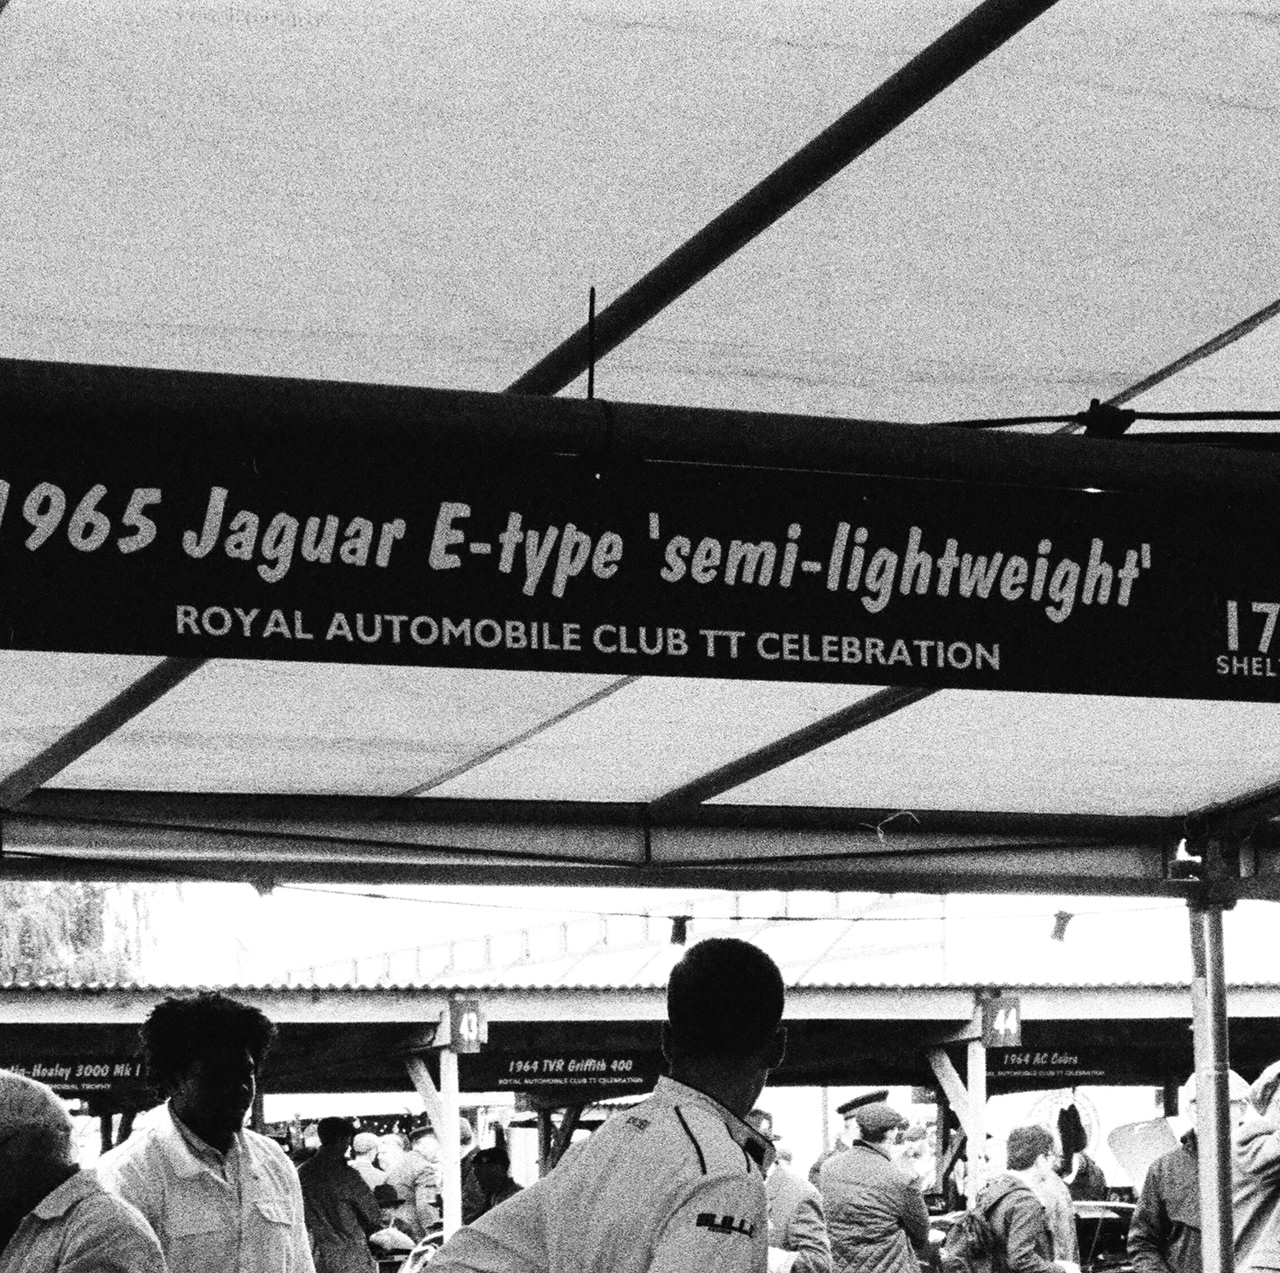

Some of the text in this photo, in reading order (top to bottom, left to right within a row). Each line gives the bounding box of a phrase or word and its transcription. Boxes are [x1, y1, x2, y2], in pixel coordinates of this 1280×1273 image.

[183, 486, 406, 583] Jaguar
[429, 502, 623, 598] E-type
[649, 512, 1151, 623] 'semi-lightweight'
[177, 605, 1000, 670] ROYAL AUTOMOBILE CLUB TT CELEBRATION
[460, 1012, 477, 1040] 43
[994, 1009, 1017, 1034] 44
[76, 1065, 110, 1077] 3000
[113, 1064, 131, 1077] Mk
[509, 1058, 633, 1073] 1964 TVR Griffith 400
[1051, 1051, 1078, 1065] Cobra
